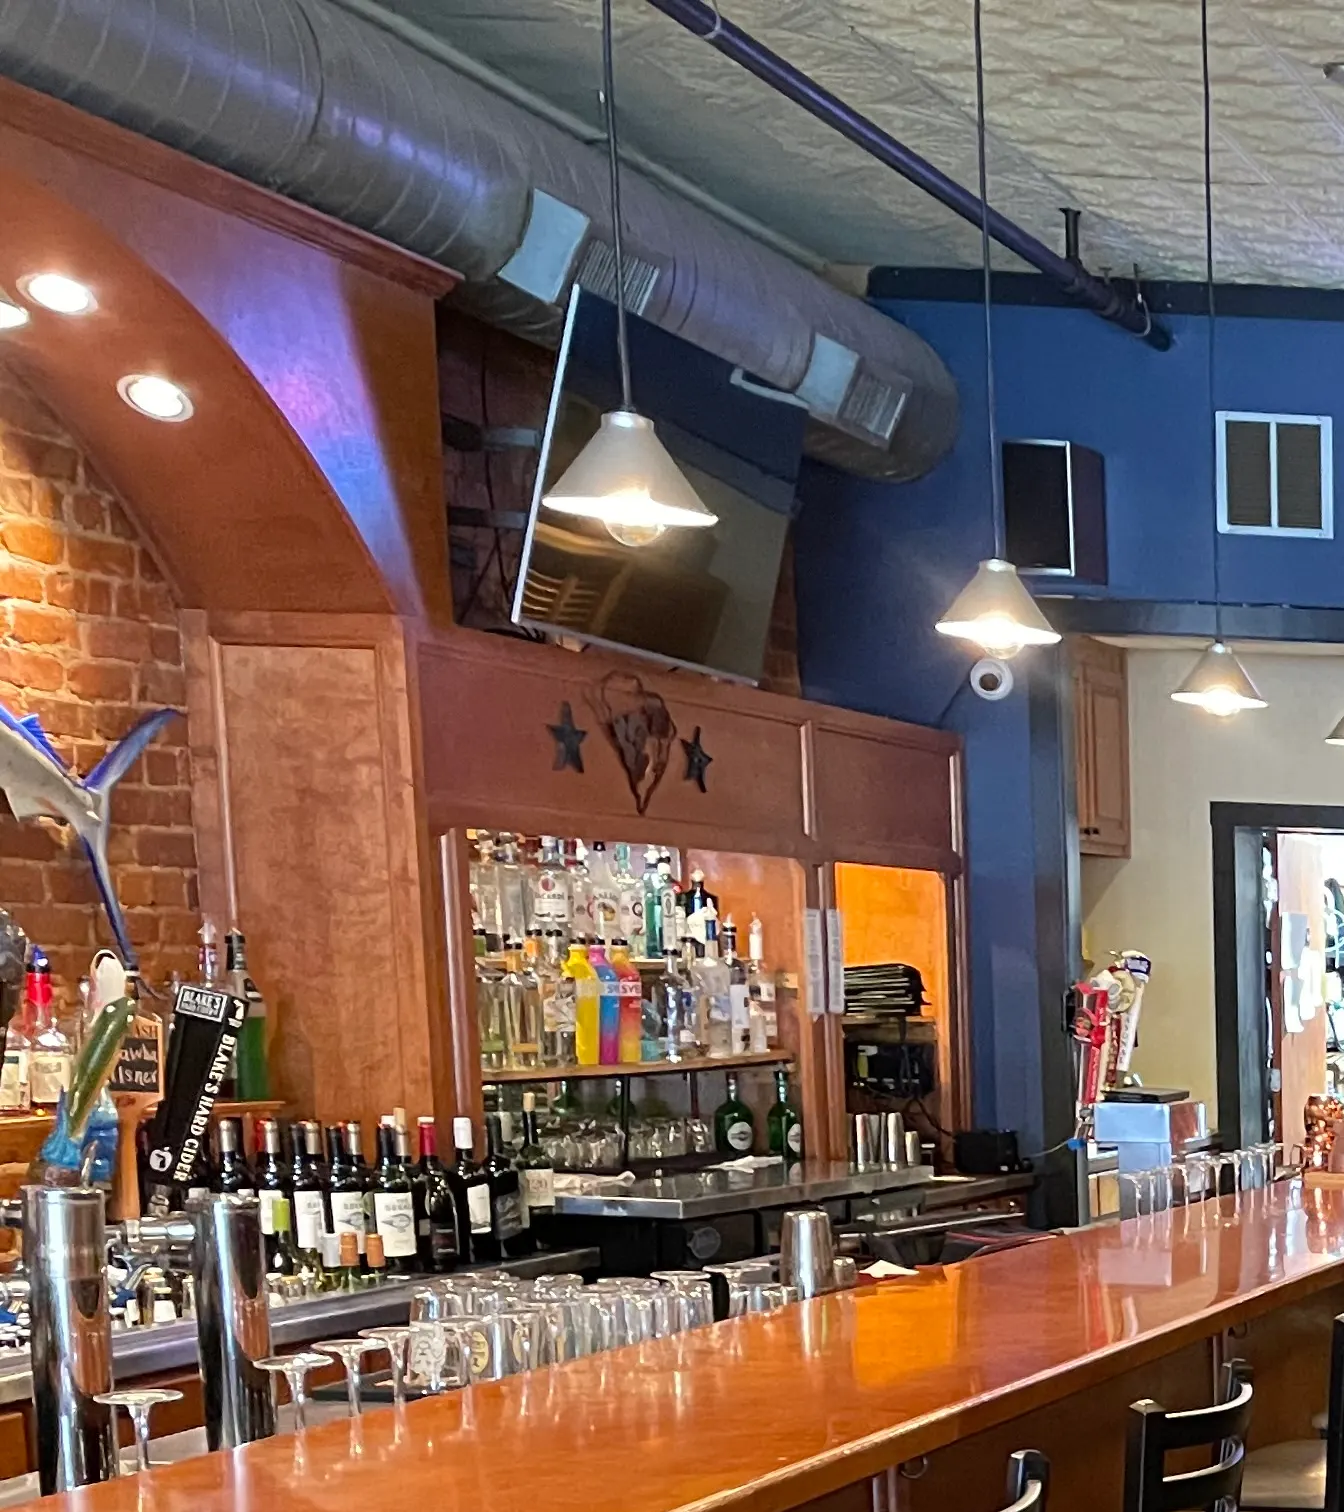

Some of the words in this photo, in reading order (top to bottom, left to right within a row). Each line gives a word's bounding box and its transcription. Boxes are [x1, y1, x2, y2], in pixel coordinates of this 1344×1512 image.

[204, 1034, 236, 1093] BLAKE'S
[190, 1093, 214, 1137] HARD
[173, 1137, 199, 1183] CIDER
